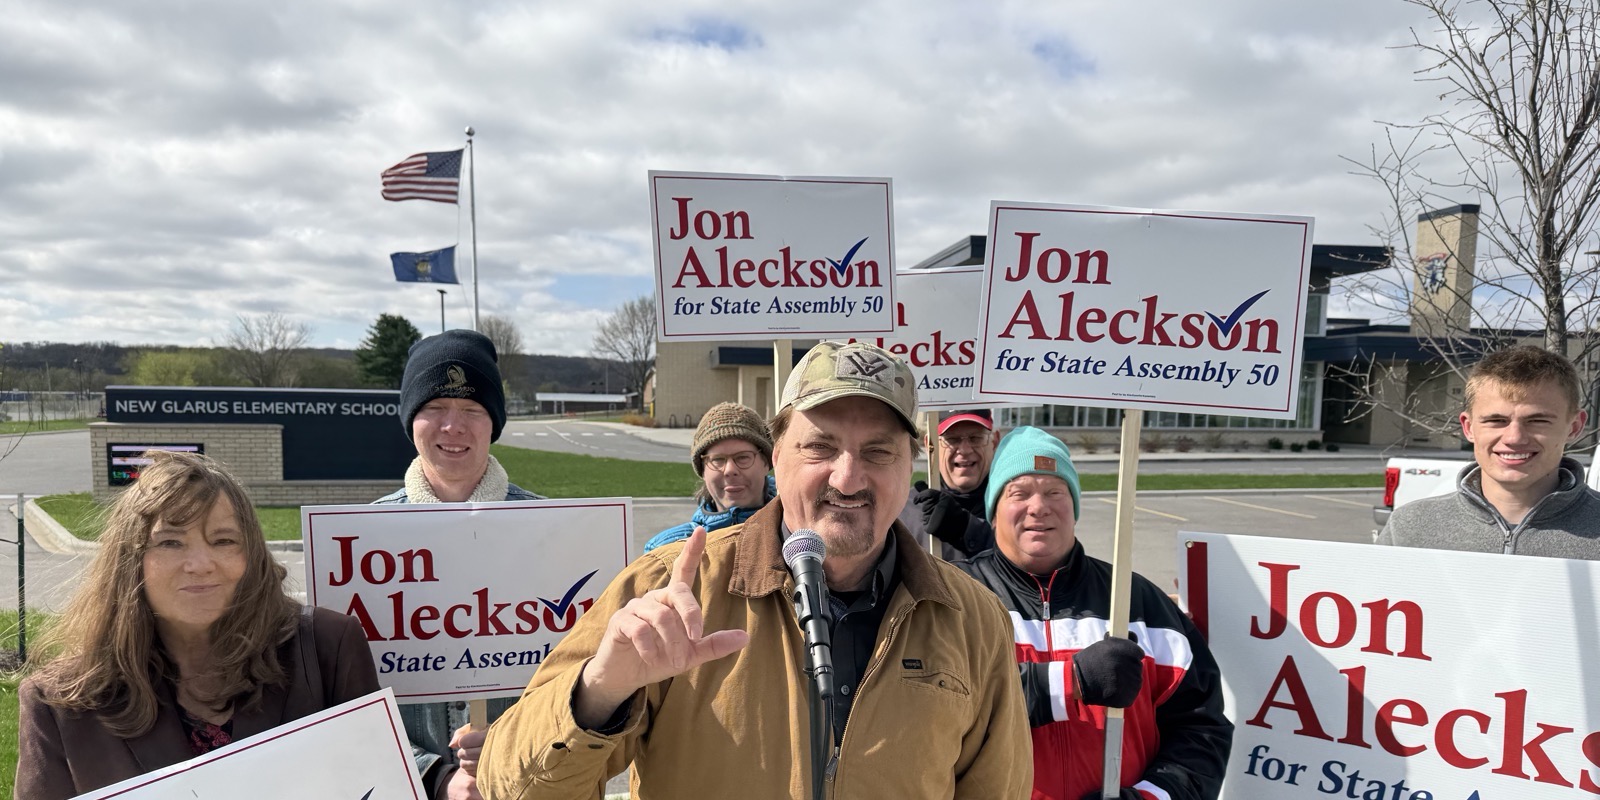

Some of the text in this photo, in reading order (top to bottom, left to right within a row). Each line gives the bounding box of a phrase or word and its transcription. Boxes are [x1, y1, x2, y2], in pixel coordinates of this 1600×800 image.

[669, 197, 754, 241] Jon
[671, 245, 883, 289] Aleckson
[1004, 231, 1112, 285] Jon
[673, 295, 884, 318] for State Assembly 50
[998, 289, 1282, 354] Aleckson
[994, 348, 1280, 389] for State Assembly 50
[115, 400, 157, 414] NEW
[161, 400, 230, 415] GLARUS
[232, 401, 338, 416] ELEMENTARY
[328, 535, 440, 587] Jon
[346, 587, 595, 642] Aleckso
[1249, 560, 1432, 662] Jon
[379, 651, 447, 674] State
[1243, 744, 1308, 787] for
